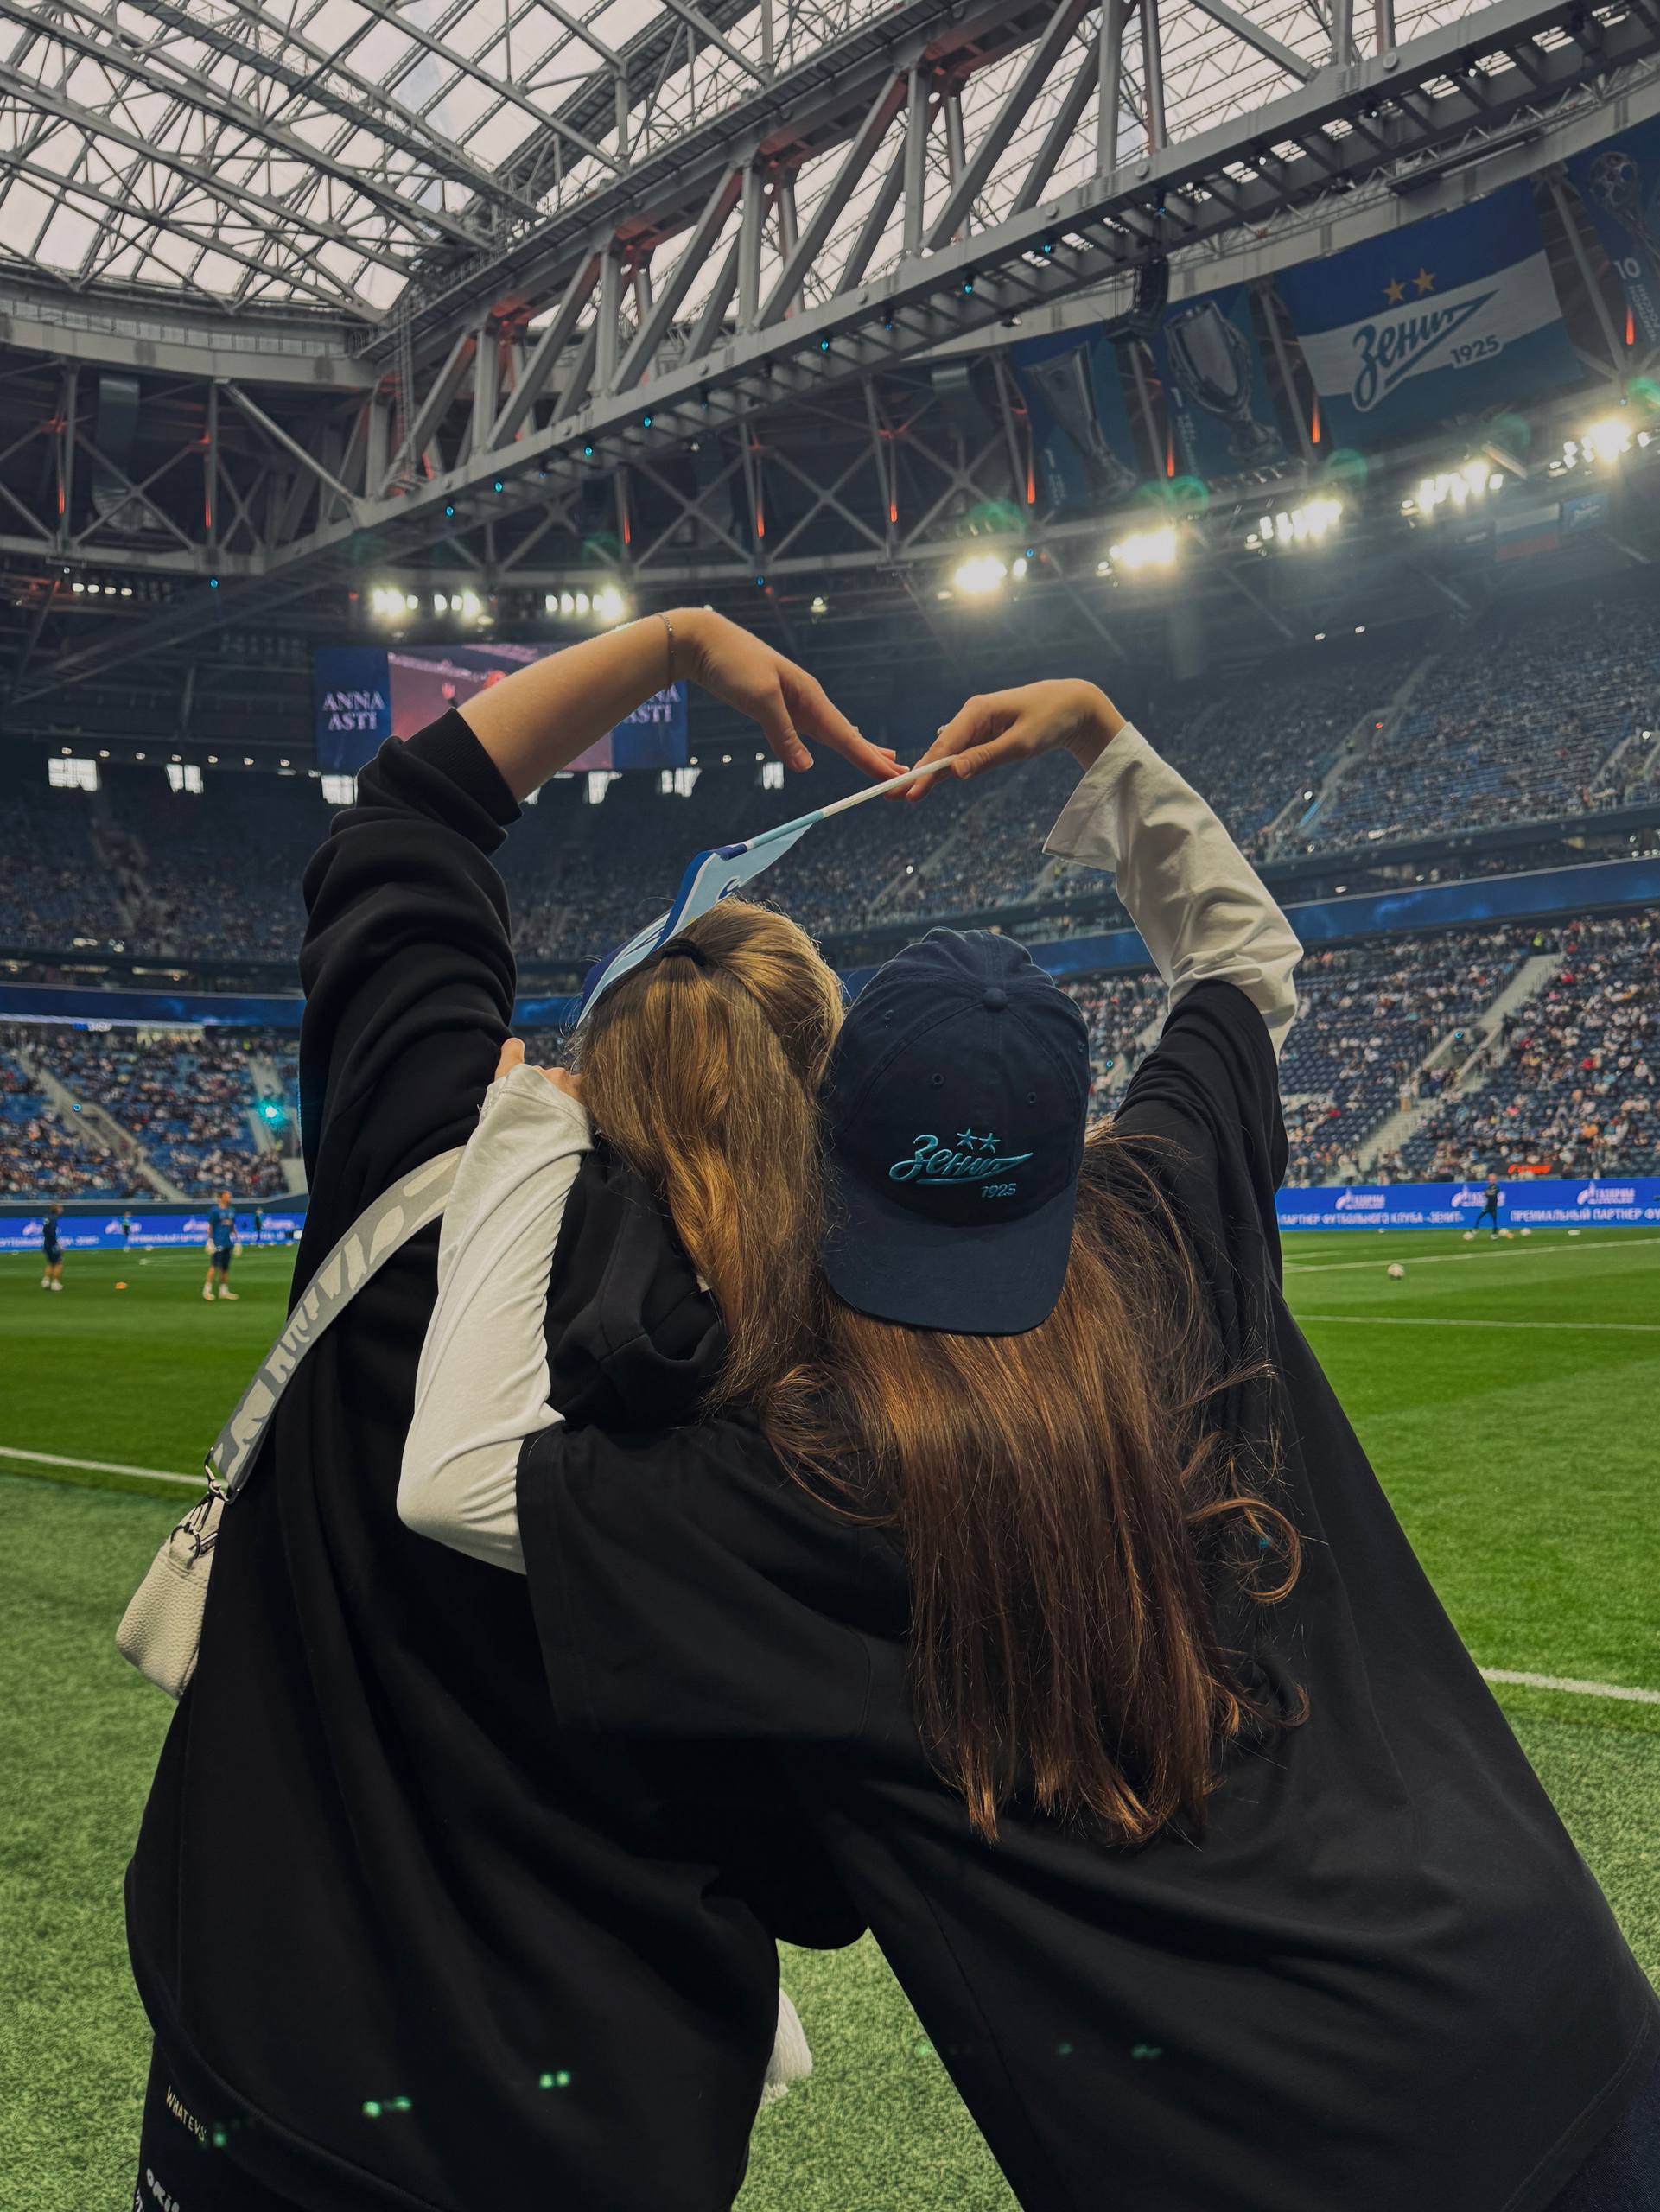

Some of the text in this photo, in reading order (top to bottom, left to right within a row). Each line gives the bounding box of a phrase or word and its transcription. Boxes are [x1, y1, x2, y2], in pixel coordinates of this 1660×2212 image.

[1615, 258, 1639, 279] 10
[1450, 336, 1499, 363] 1925
[322, 690, 385, 711] ANNA
[328, 711, 378, 731] ASTI
[982, 1183, 1017, 1198] 1925
[1391, 1211, 1423, 1224] КЛУБА
[1593, 1208, 1643, 1221] ПАРТНЕР
